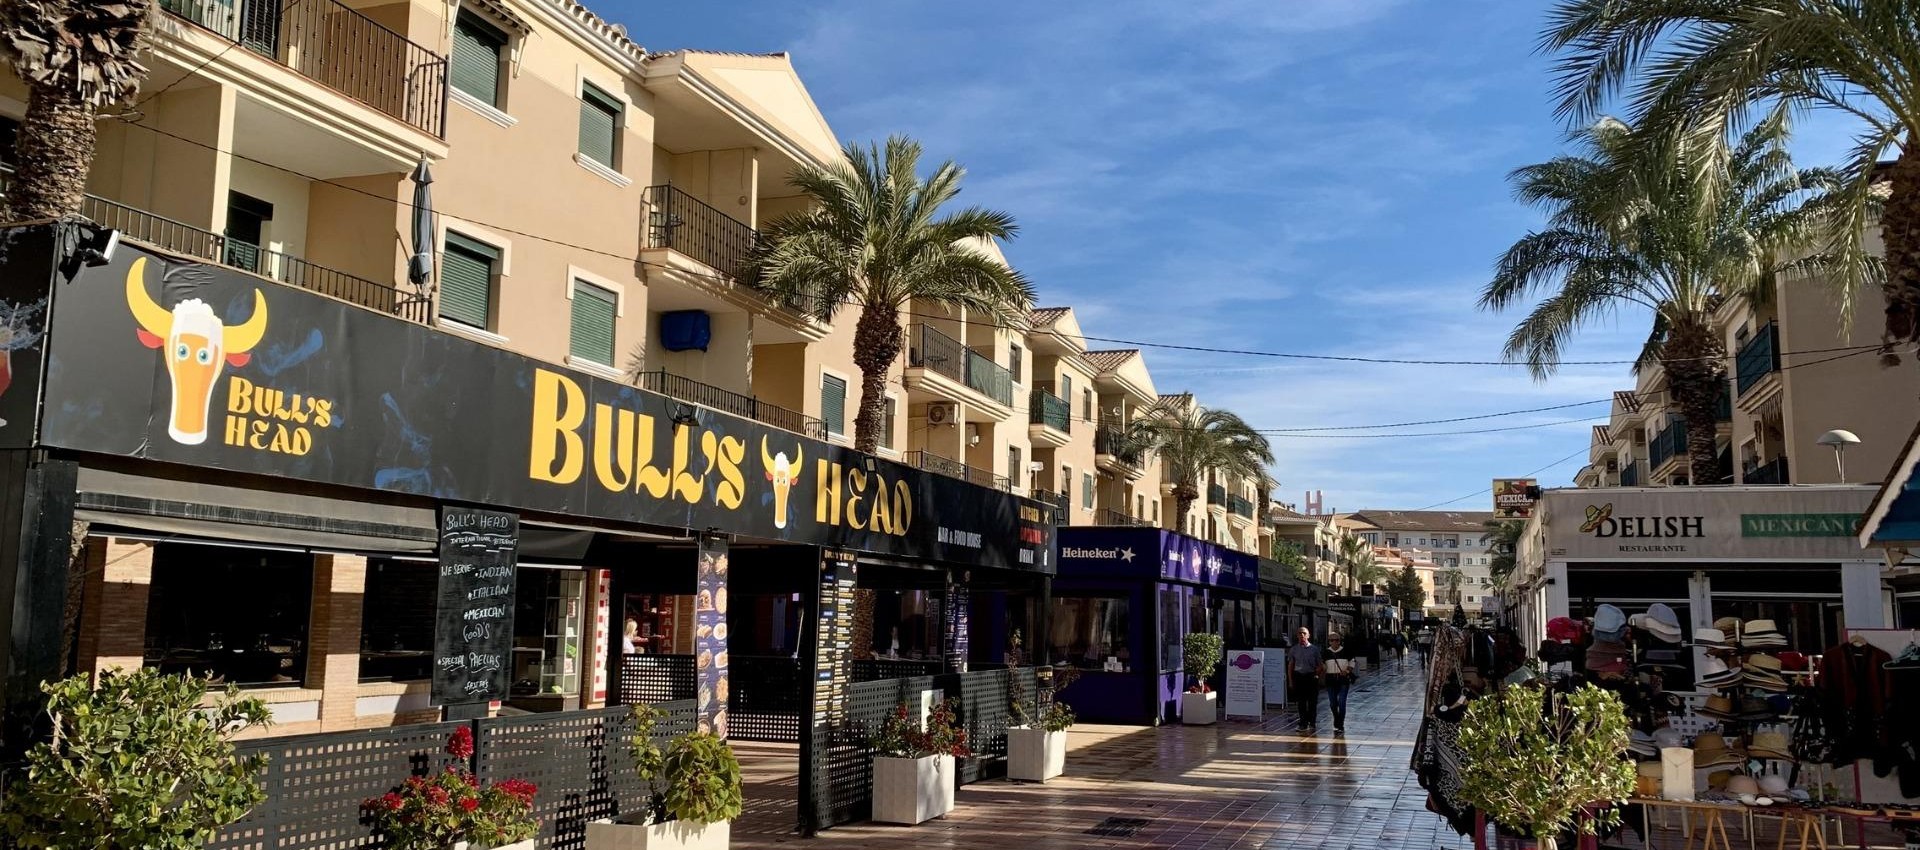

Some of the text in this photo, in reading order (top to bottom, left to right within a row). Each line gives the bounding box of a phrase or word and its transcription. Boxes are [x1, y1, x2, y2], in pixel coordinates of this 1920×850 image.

[228, 375, 331, 427] BULL'S
[224, 414, 313, 457] HEAD
[530, 368, 912, 536] BULL'S HEAD
[481, 515, 509, 529] HEAD
[1594, 515, 1706, 538] DELISH
[1749, 518, 1844, 532] MEXICAN
[954, 530, 967, 546] FOOD
[1062, 547, 1117, 559] Heineken
[1619, 545, 1687, 553] RESTAURANTE
[441, 565, 453, 577] WE
